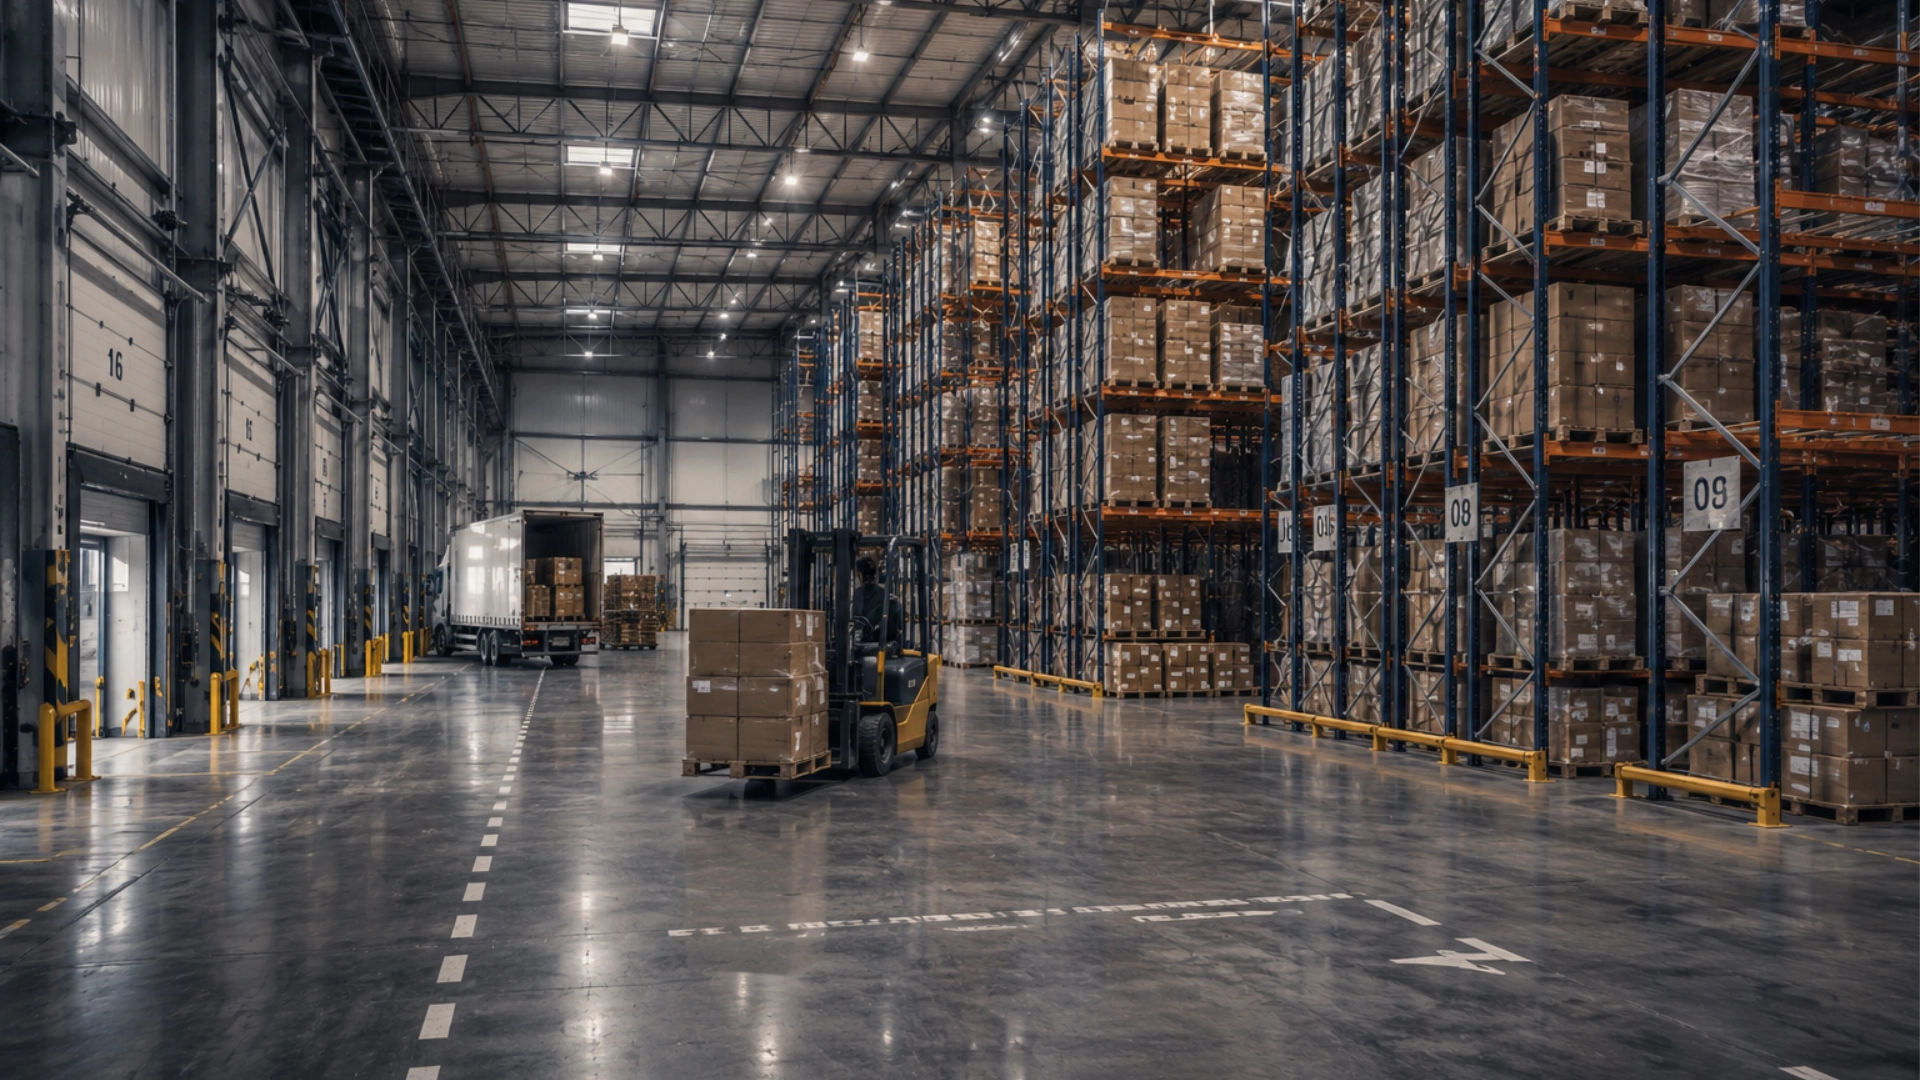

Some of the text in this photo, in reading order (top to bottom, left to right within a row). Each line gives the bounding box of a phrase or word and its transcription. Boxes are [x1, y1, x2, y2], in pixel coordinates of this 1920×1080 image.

[108, 348, 123, 381] 16
[1694, 475, 1728, 511] 09
[1451, 498, 1471, 528] 08
